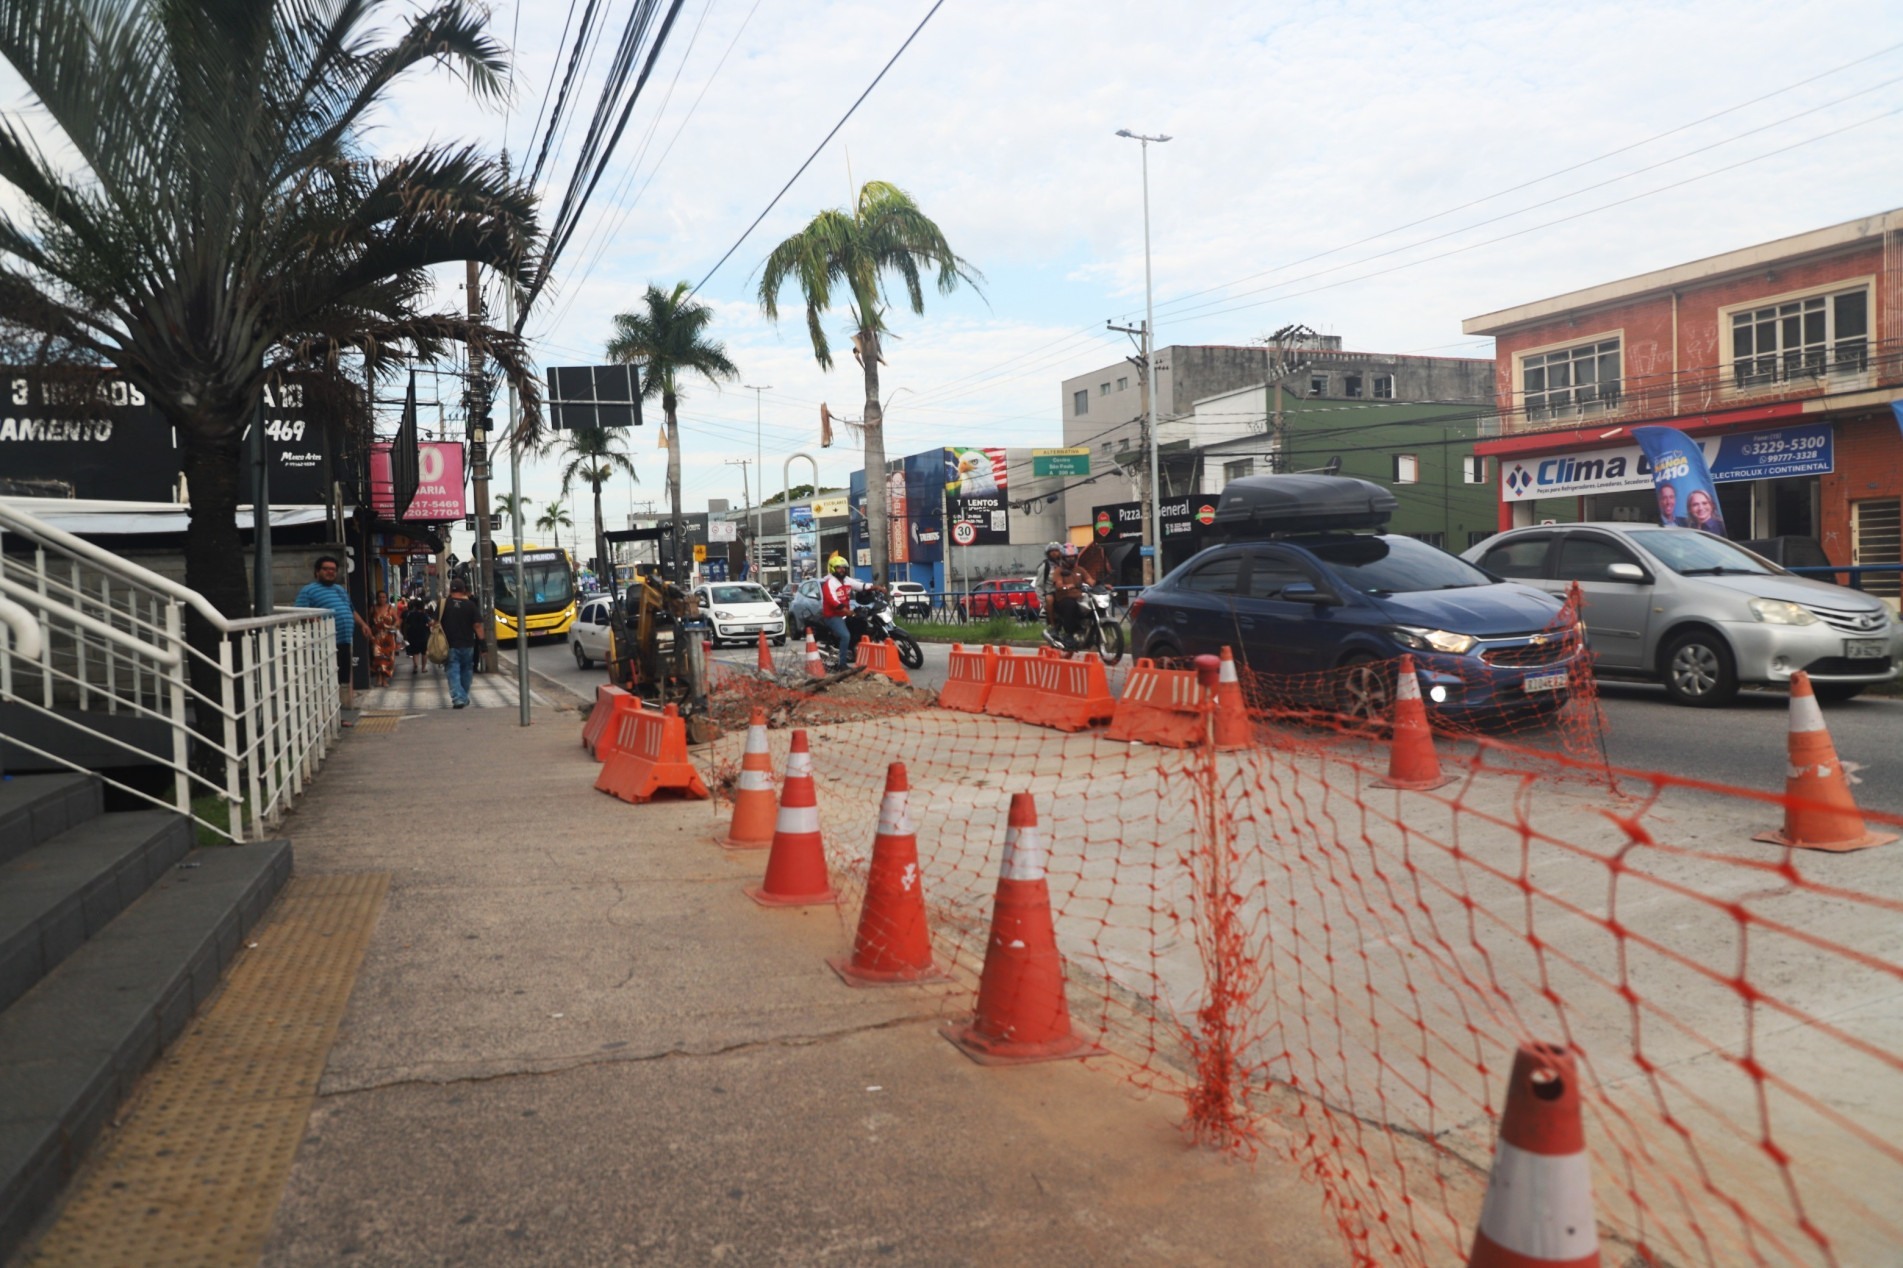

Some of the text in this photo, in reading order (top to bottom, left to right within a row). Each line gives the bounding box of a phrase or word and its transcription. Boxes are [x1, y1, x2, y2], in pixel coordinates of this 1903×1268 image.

[12, 378, 28, 405] 3
[1752, 436, 1826, 455] 3229-5300
[1537, 456, 1627, 486] Clima
[1711, 469, 1763, 480] ELECTROLUX
[1768, 462, 1829, 475] CONTINENTAL
[957, 499, 999, 507] TLENTOS
[1158, 499, 1190, 517] eneral
[404, 509, 460, 517] 202-7704
[957, 525, 972, 536] 30
